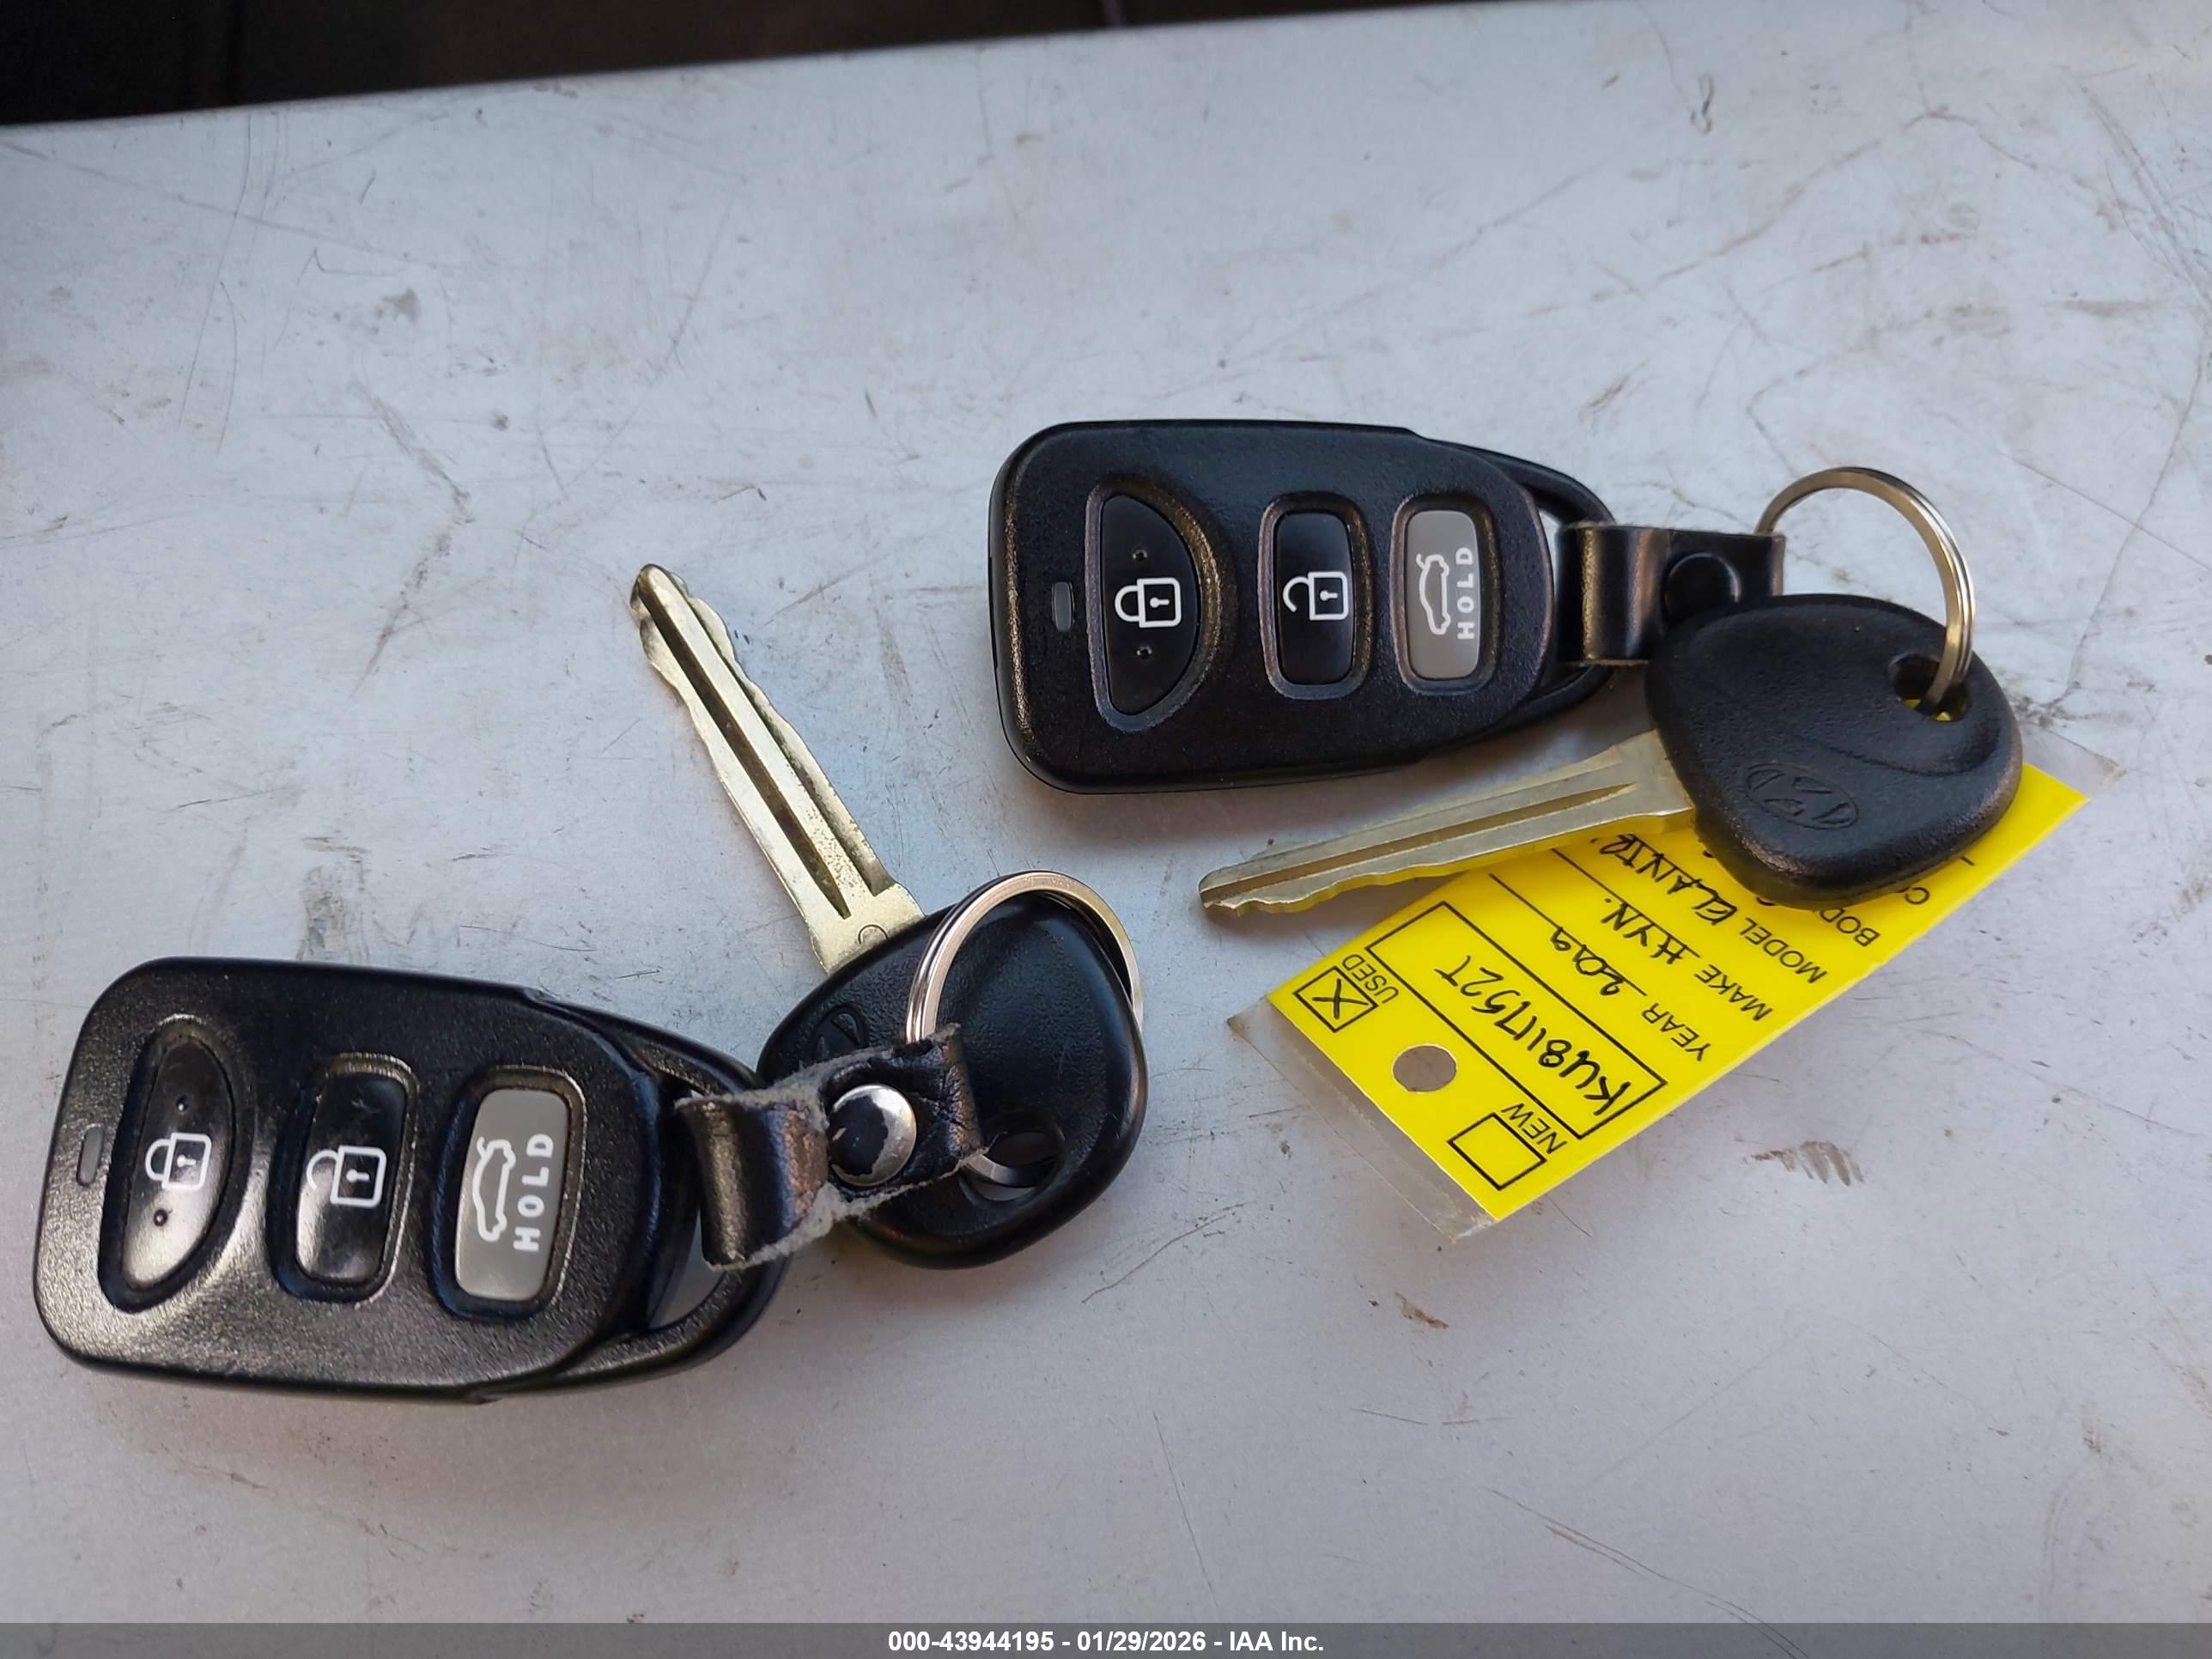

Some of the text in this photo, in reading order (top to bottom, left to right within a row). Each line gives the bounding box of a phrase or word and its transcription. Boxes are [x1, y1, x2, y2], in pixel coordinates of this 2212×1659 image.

[1455, 547, 1474, 640] HOLD
[1590, 833, 1738, 926] ELANTR
[1740, 917, 1828, 984] MODEL
[1819, 907, 1881, 947] BOD
[1341, 953, 1399, 1004] USED
[1550, 927, 1711, 1062] YEAR 2019
[1694, 963, 1773, 1022] MAKE
[1501, 1103, 1568, 1154] NEW
[513, 1133, 554, 1252] HOLD
